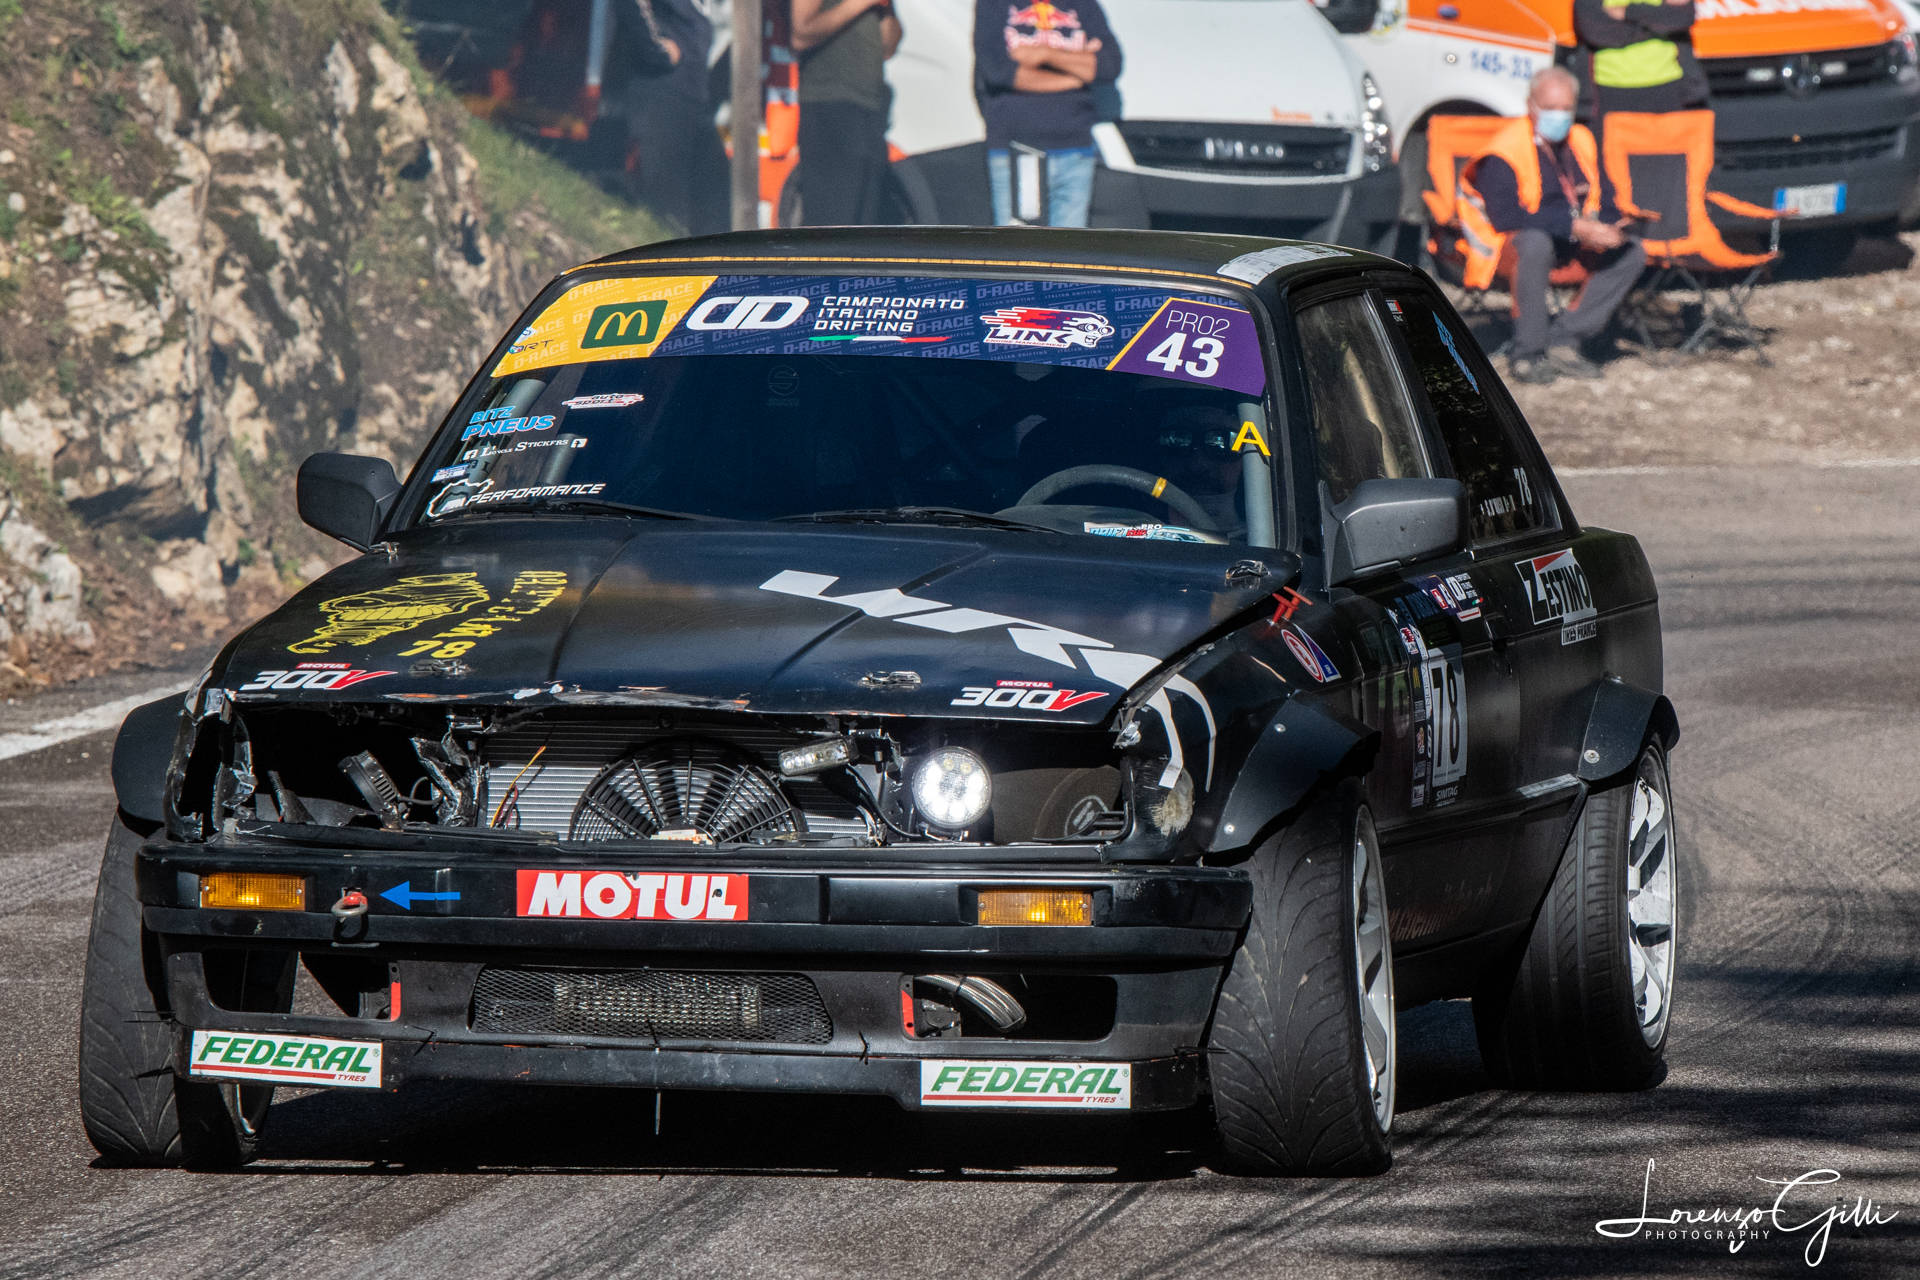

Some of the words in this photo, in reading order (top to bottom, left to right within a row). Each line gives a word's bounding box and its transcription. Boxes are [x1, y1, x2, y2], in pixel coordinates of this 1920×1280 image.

[818, 308, 919, 320] ITALIANO
[822, 296, 965, 310] CAMPIONATO
[814, 320, 914, 333] DRIFTING
[989, 328, 1073, 343] LINK
[1166, 310, 1230, 339] PRO2
[1146, 332, 1225, 378] 43
[470, 405, 517, 425] BITZ
[461, 415, 556, 441] PNEUS
[1231, 421, 1271, 456] A
[465, 483, 606, 506] PERFORMANCE
[1515, 562, 1592, 624] ZESTINO
[396, 640, 477, 659] 78
[239, 669, 399, 690] 300V
[950, 687, 1110, 712] 300V
[1431, 662, 1460, 767] 78
[527, 873, 738, 920] MOTUL
[198, 1036, 372, 1073] FEDERAL
[337, 1074, 367, 1082] TYRES
[930, 1066, 1122, 1095] FEDERAL
[1085, 1096, 1116, 1104] TYRES
